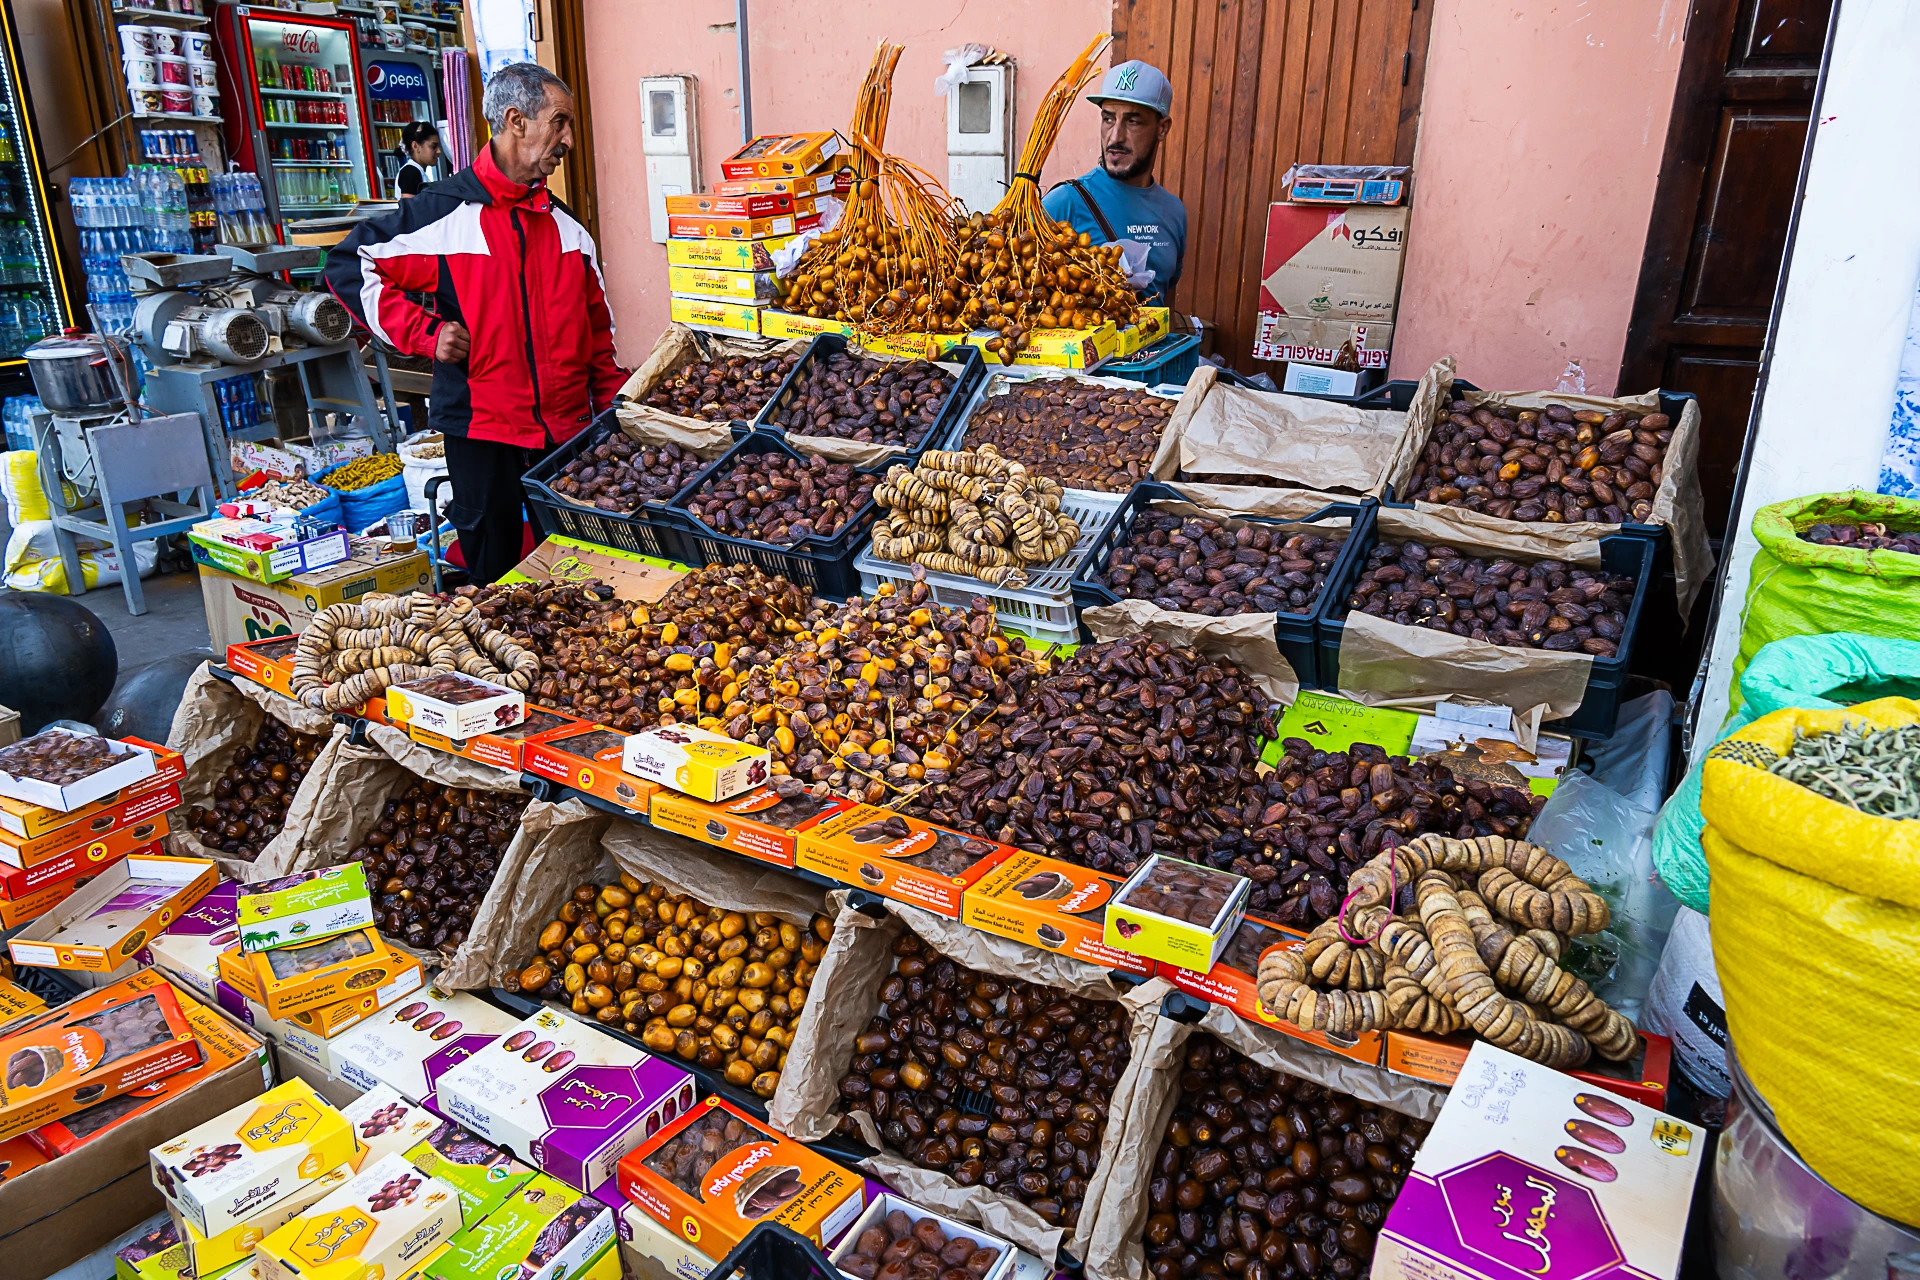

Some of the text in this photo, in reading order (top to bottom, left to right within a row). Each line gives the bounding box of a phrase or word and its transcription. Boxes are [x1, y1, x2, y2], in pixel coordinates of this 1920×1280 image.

[389, 74, 425, 89] pepsi
[1127, 225, 1159, 234] NEW YORK
[786, 327, 804, 335] DATTES
[1275, 345, 1333, 362] FRAGILE
[1302, 697, 1365, 717] STANDARD
[1073, 946, 1147, 973] Dattes naturelles Marocaine
[1079, 941, 1143, 964] Natural Moroccan Dates
[117, 1056, 193, 1090] Dattes naturelles Marocaine
[121, 1054, 187, 1083] Natural Moroccan Dates
[784, 1197, 805, 1215] Khair
[1491, 1182, 1514, 1229] تمور
[1501, 1174, 1558, 1275] المجهول
[469, 1251, 495, 1273] Dattes
[494, 1220, 530, 1252] Al-Majhoul
